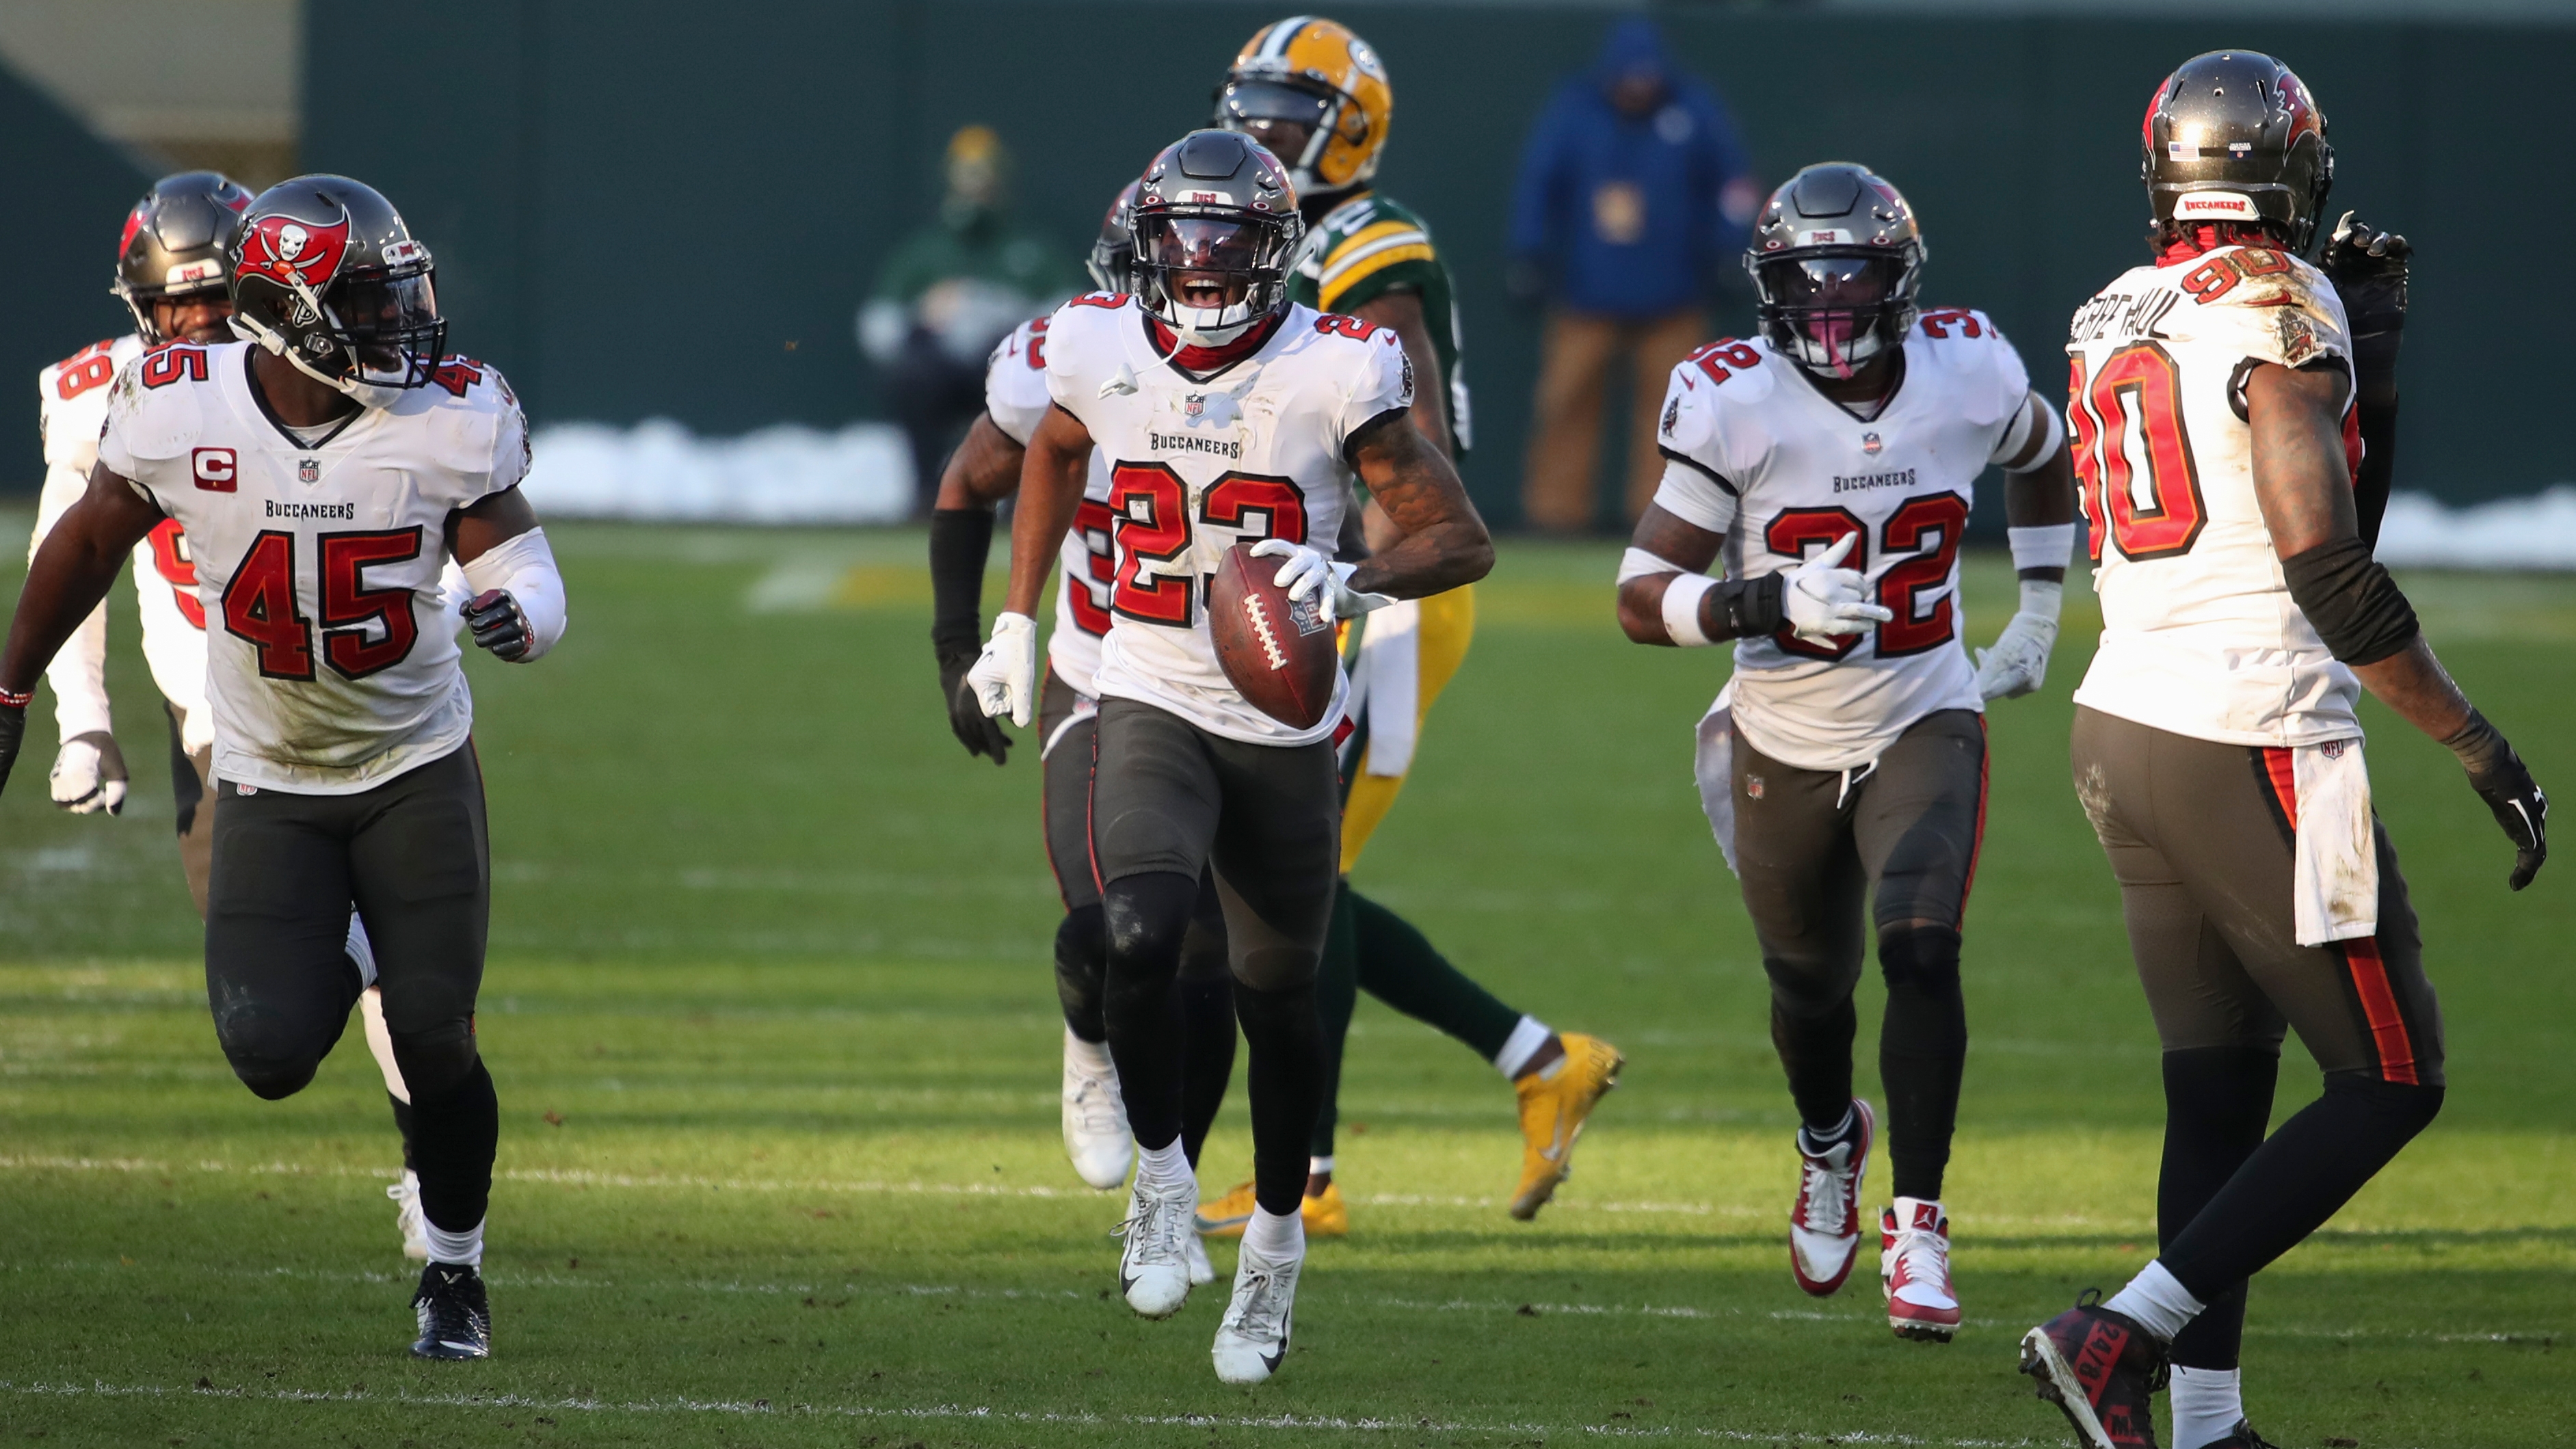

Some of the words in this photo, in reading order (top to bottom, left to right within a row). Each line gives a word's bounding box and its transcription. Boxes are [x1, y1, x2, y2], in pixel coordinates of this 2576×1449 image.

[2181, 246, 2292, 305] 90
[1068, 291, 1130, 310] 3
[1314, 313, 1380, 343] 2
[1920, 306, 1982, 339] 3
[141, 336, 209, 390] 5
[1186, 403, 1203, 413] NFL
[1148, 432, 1239, 460] BUCCANEERS
[195, 450, 233, 481] C
[301, 468, 317, 479] NFL
[1833, 468, 1915, 493] BUCCANEERS
[264, 500, 355, 522] BUCCANEERS
[1764, 489, 1968, 663] 32
[220, 524, 423, 682] 45
[2323, 741, 2343, 756] NFL
